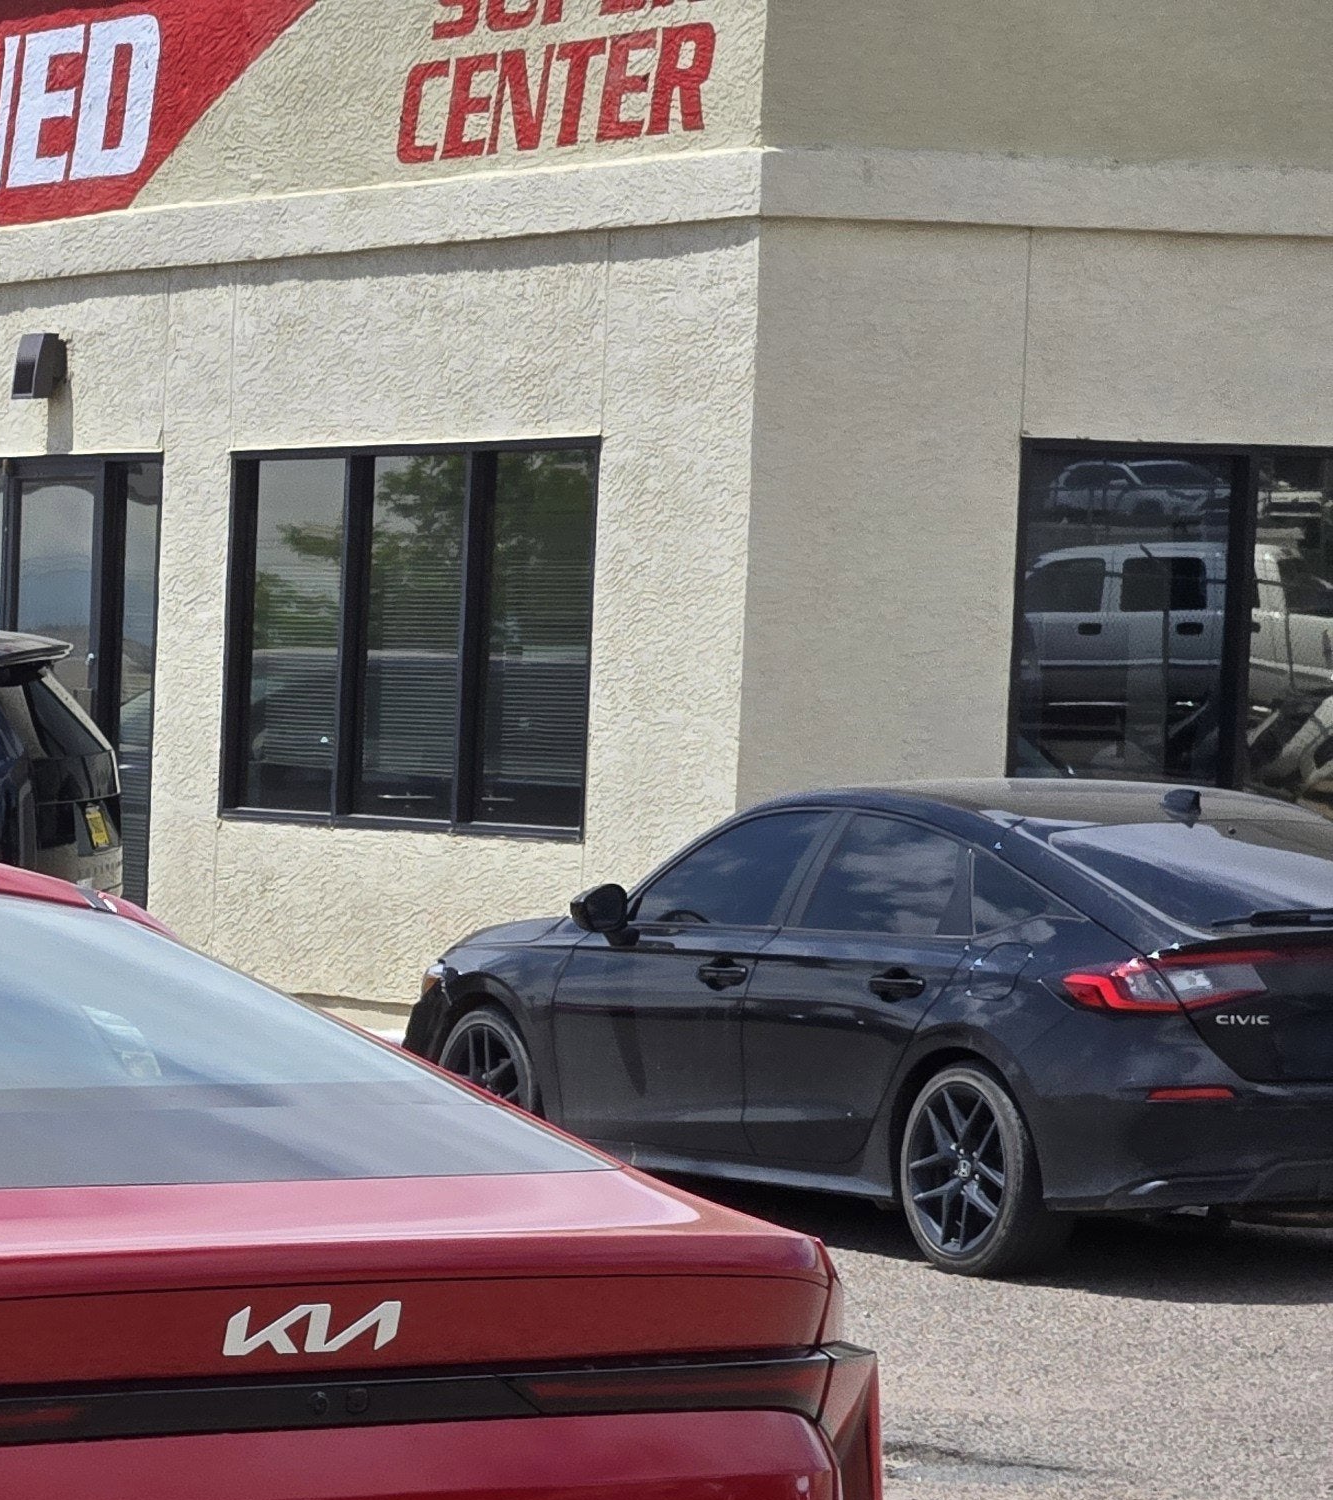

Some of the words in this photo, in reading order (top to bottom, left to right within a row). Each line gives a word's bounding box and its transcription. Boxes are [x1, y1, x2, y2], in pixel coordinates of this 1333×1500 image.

[397, 22, 716, 164] CENTER
[1215, 1014, 1270, 1025] CIVIC
[223, 1300, 402, 1356] KIA
